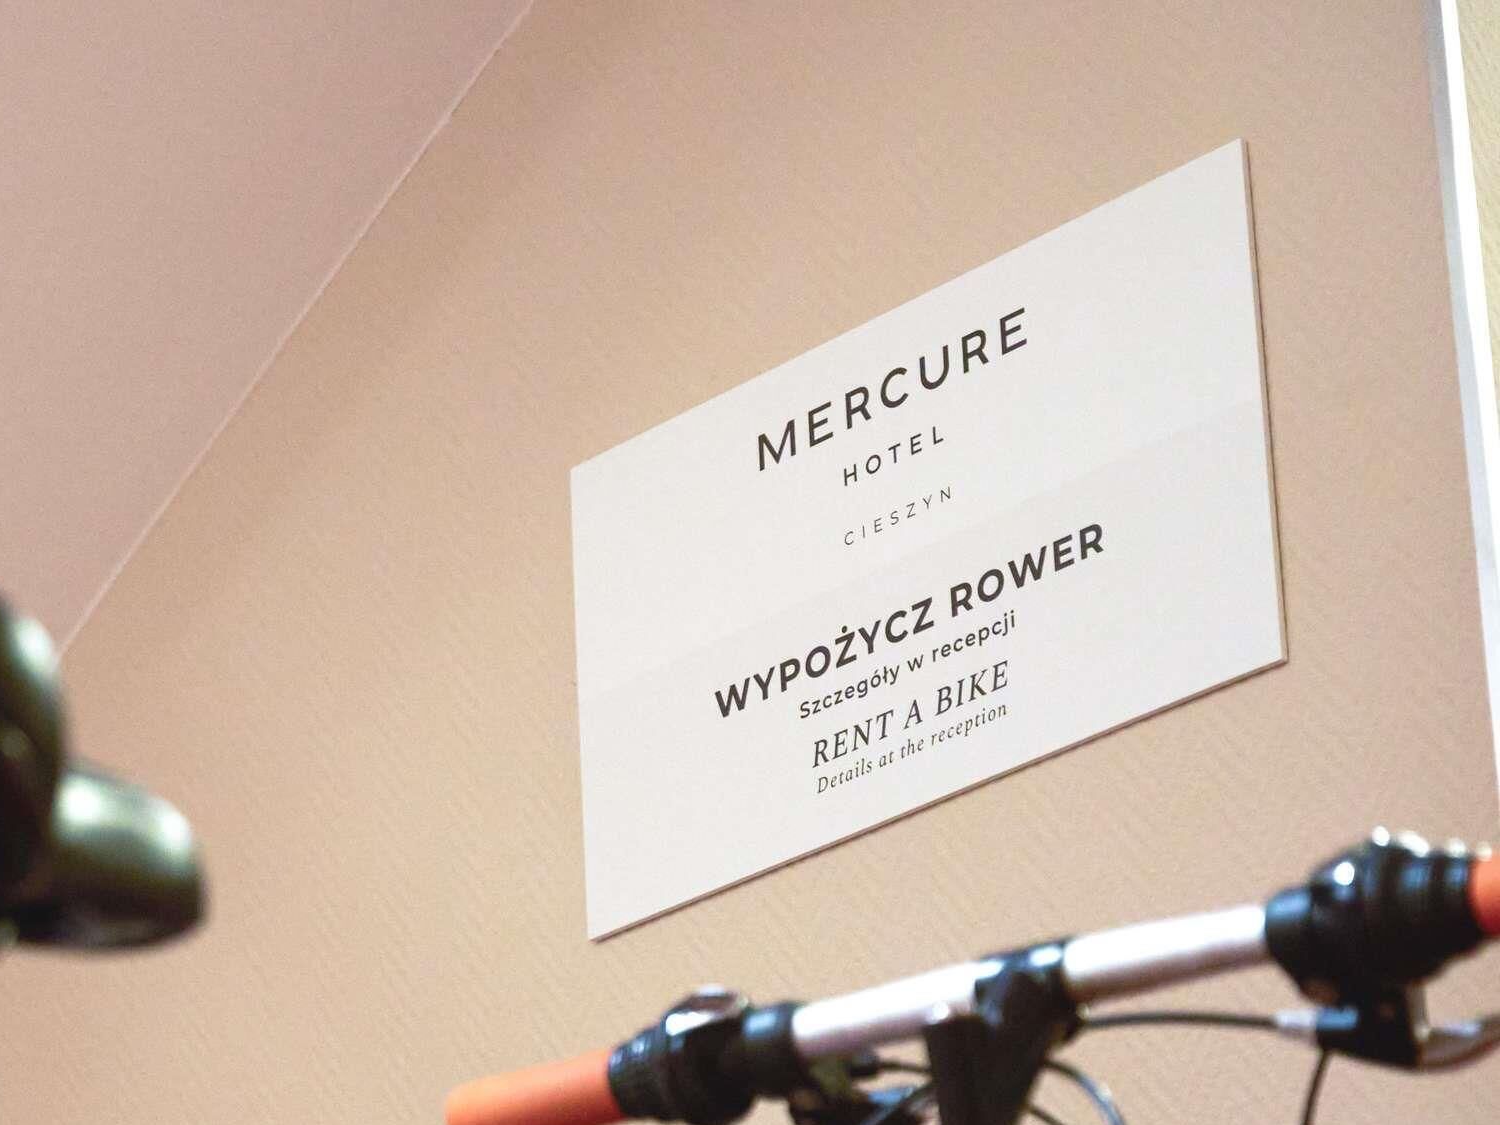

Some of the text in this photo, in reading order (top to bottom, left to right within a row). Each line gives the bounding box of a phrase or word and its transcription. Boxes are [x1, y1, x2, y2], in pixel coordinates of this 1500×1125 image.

[758, 307, 1027, 471] MERCURE
[843, 426, 944, 486] HOTEL
[844, 486, 951, 545] CIESZYN
[714, 524, 1104, 718] WYPOŻYCZ ROWER
[799, 610, 1016, 719] Szczegóły w recepcji
[812, 660, 1009, 768] RENT A BIKE
[816, 703, 1007, 794] Details at the reception
